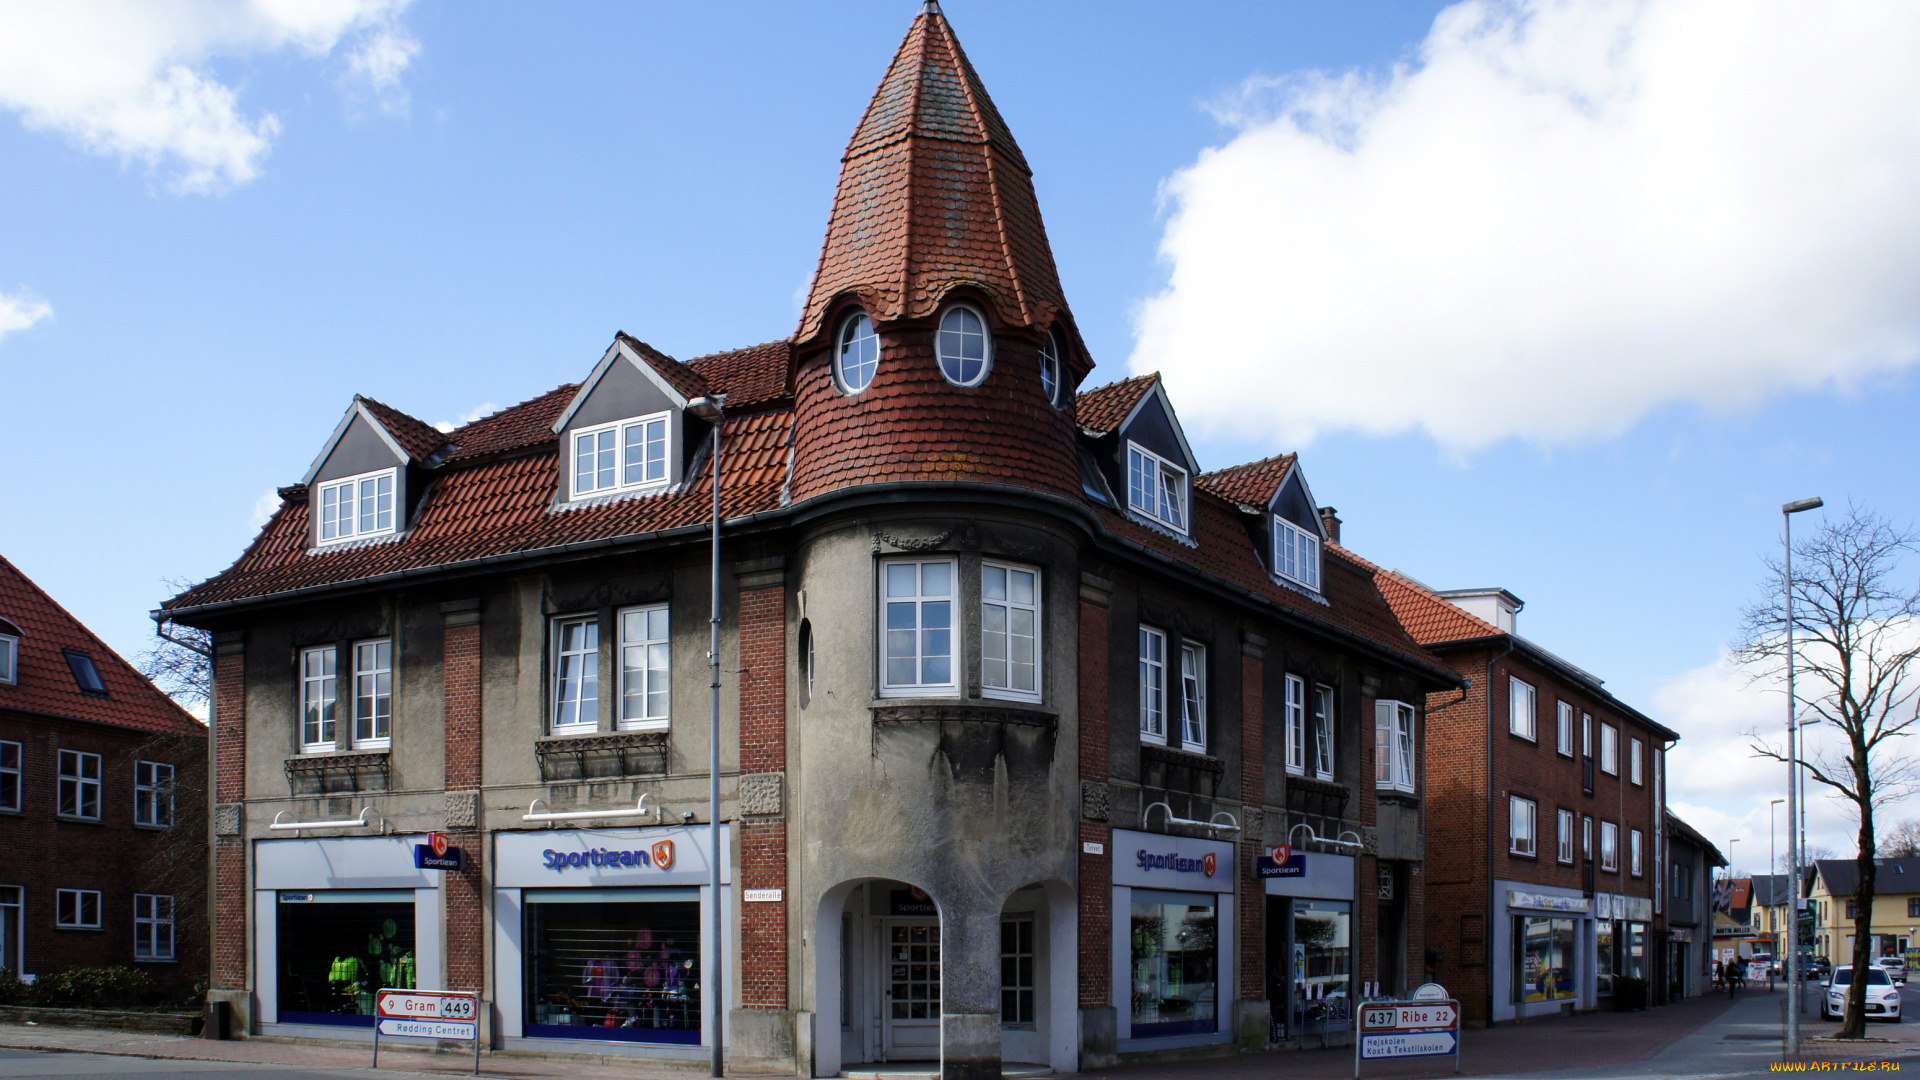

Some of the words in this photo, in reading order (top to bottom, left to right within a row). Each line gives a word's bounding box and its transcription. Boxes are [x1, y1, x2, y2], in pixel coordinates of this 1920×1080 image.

[424, 857, 458, 867] Sportigan
[542, 847, 649, 872] Sportigan
[1136, 849, 1204, 872] Sportigan
[1261, 867, 1300, 875] Sportigan
[898, 903, 937, 912] Sportiga
[388, 1000, 395, 1010] 9
[405, 999, 436, 1012] Gram
[444, 1002, 470, 1014] 449
[1368, 1012, 1393, 1025] 437
[1402, 1011, 1428, 1023] Ribe
[1435, 1011, 1449, 1022] 22
[397, 1023, 433, 1034] Rødding
[435, 1025, 470, 1036] Centret
[1367, 1038, 1405, 1046] Højskolen
[1366, 1046, 1384, 1055] Kost
[1386, 1046, 1392, 1054] &
[1394, 1044, 1444, 1054] Tekstilskolen
